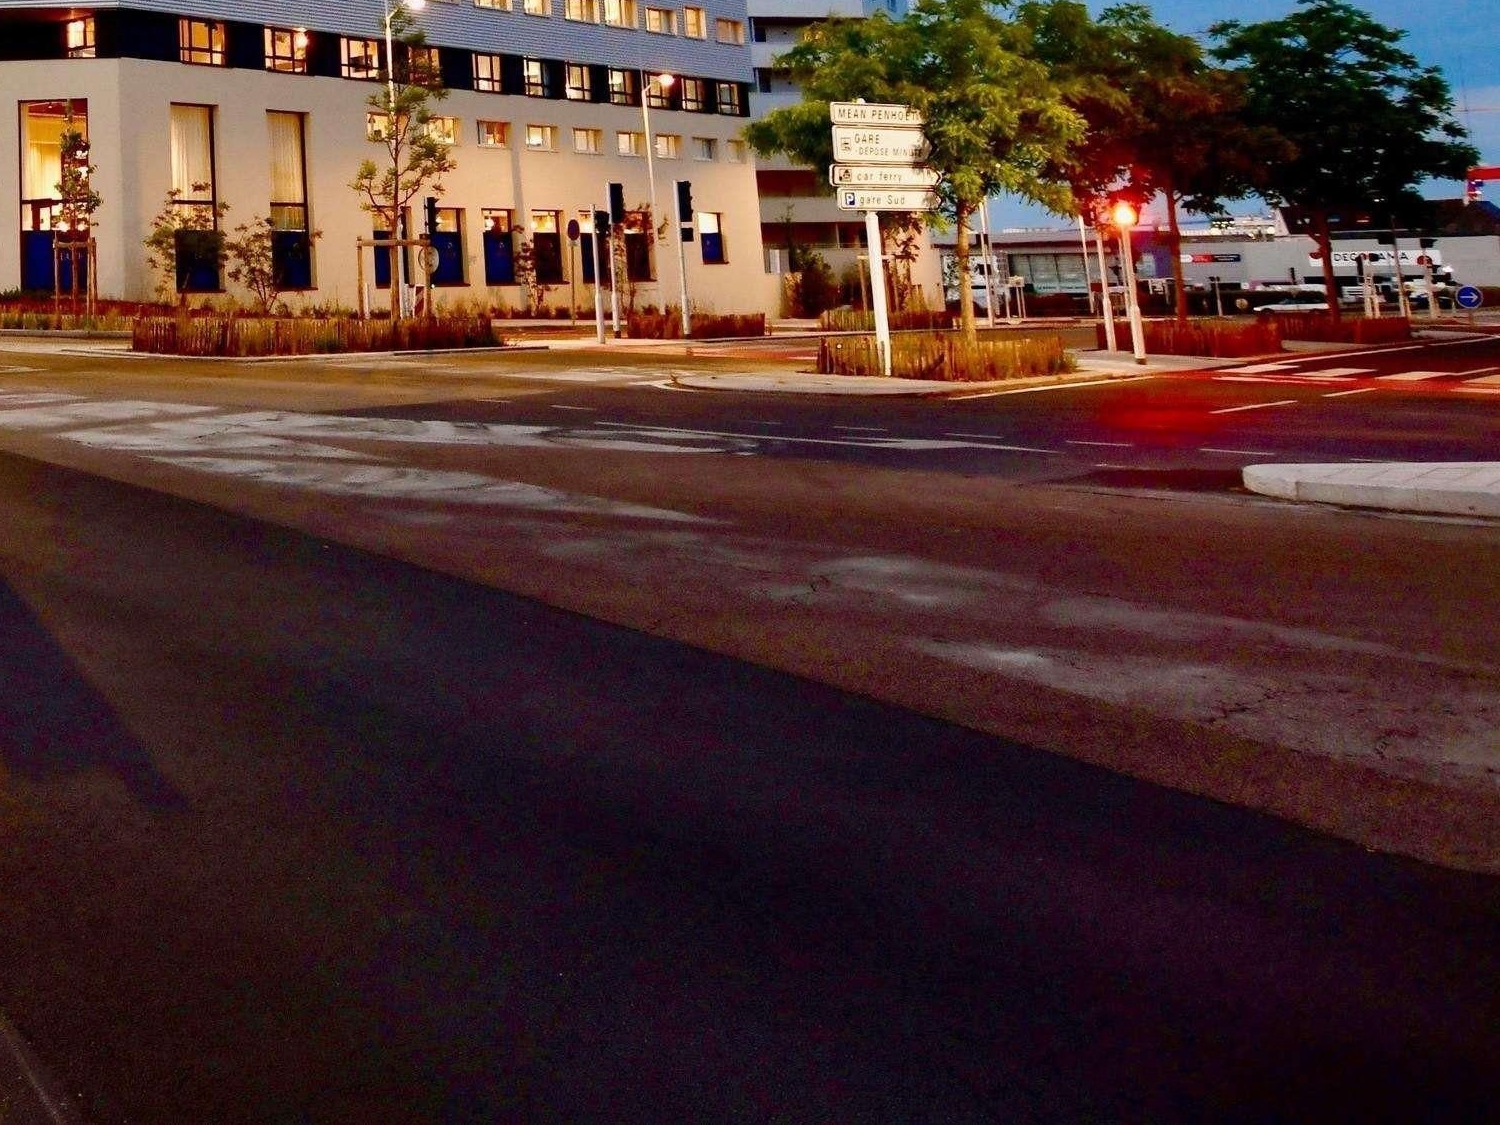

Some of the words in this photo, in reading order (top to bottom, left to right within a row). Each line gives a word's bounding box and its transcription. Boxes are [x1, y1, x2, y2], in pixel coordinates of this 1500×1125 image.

[838, 108, 867, 119] MEAN
[854, 133, 880, 145] GARE
[857, 172, 873, 181] car
[879, 171, 901, 183] ferry
[859, 195, 881, 206] gare
[887, 194, 905, 205] Sud
